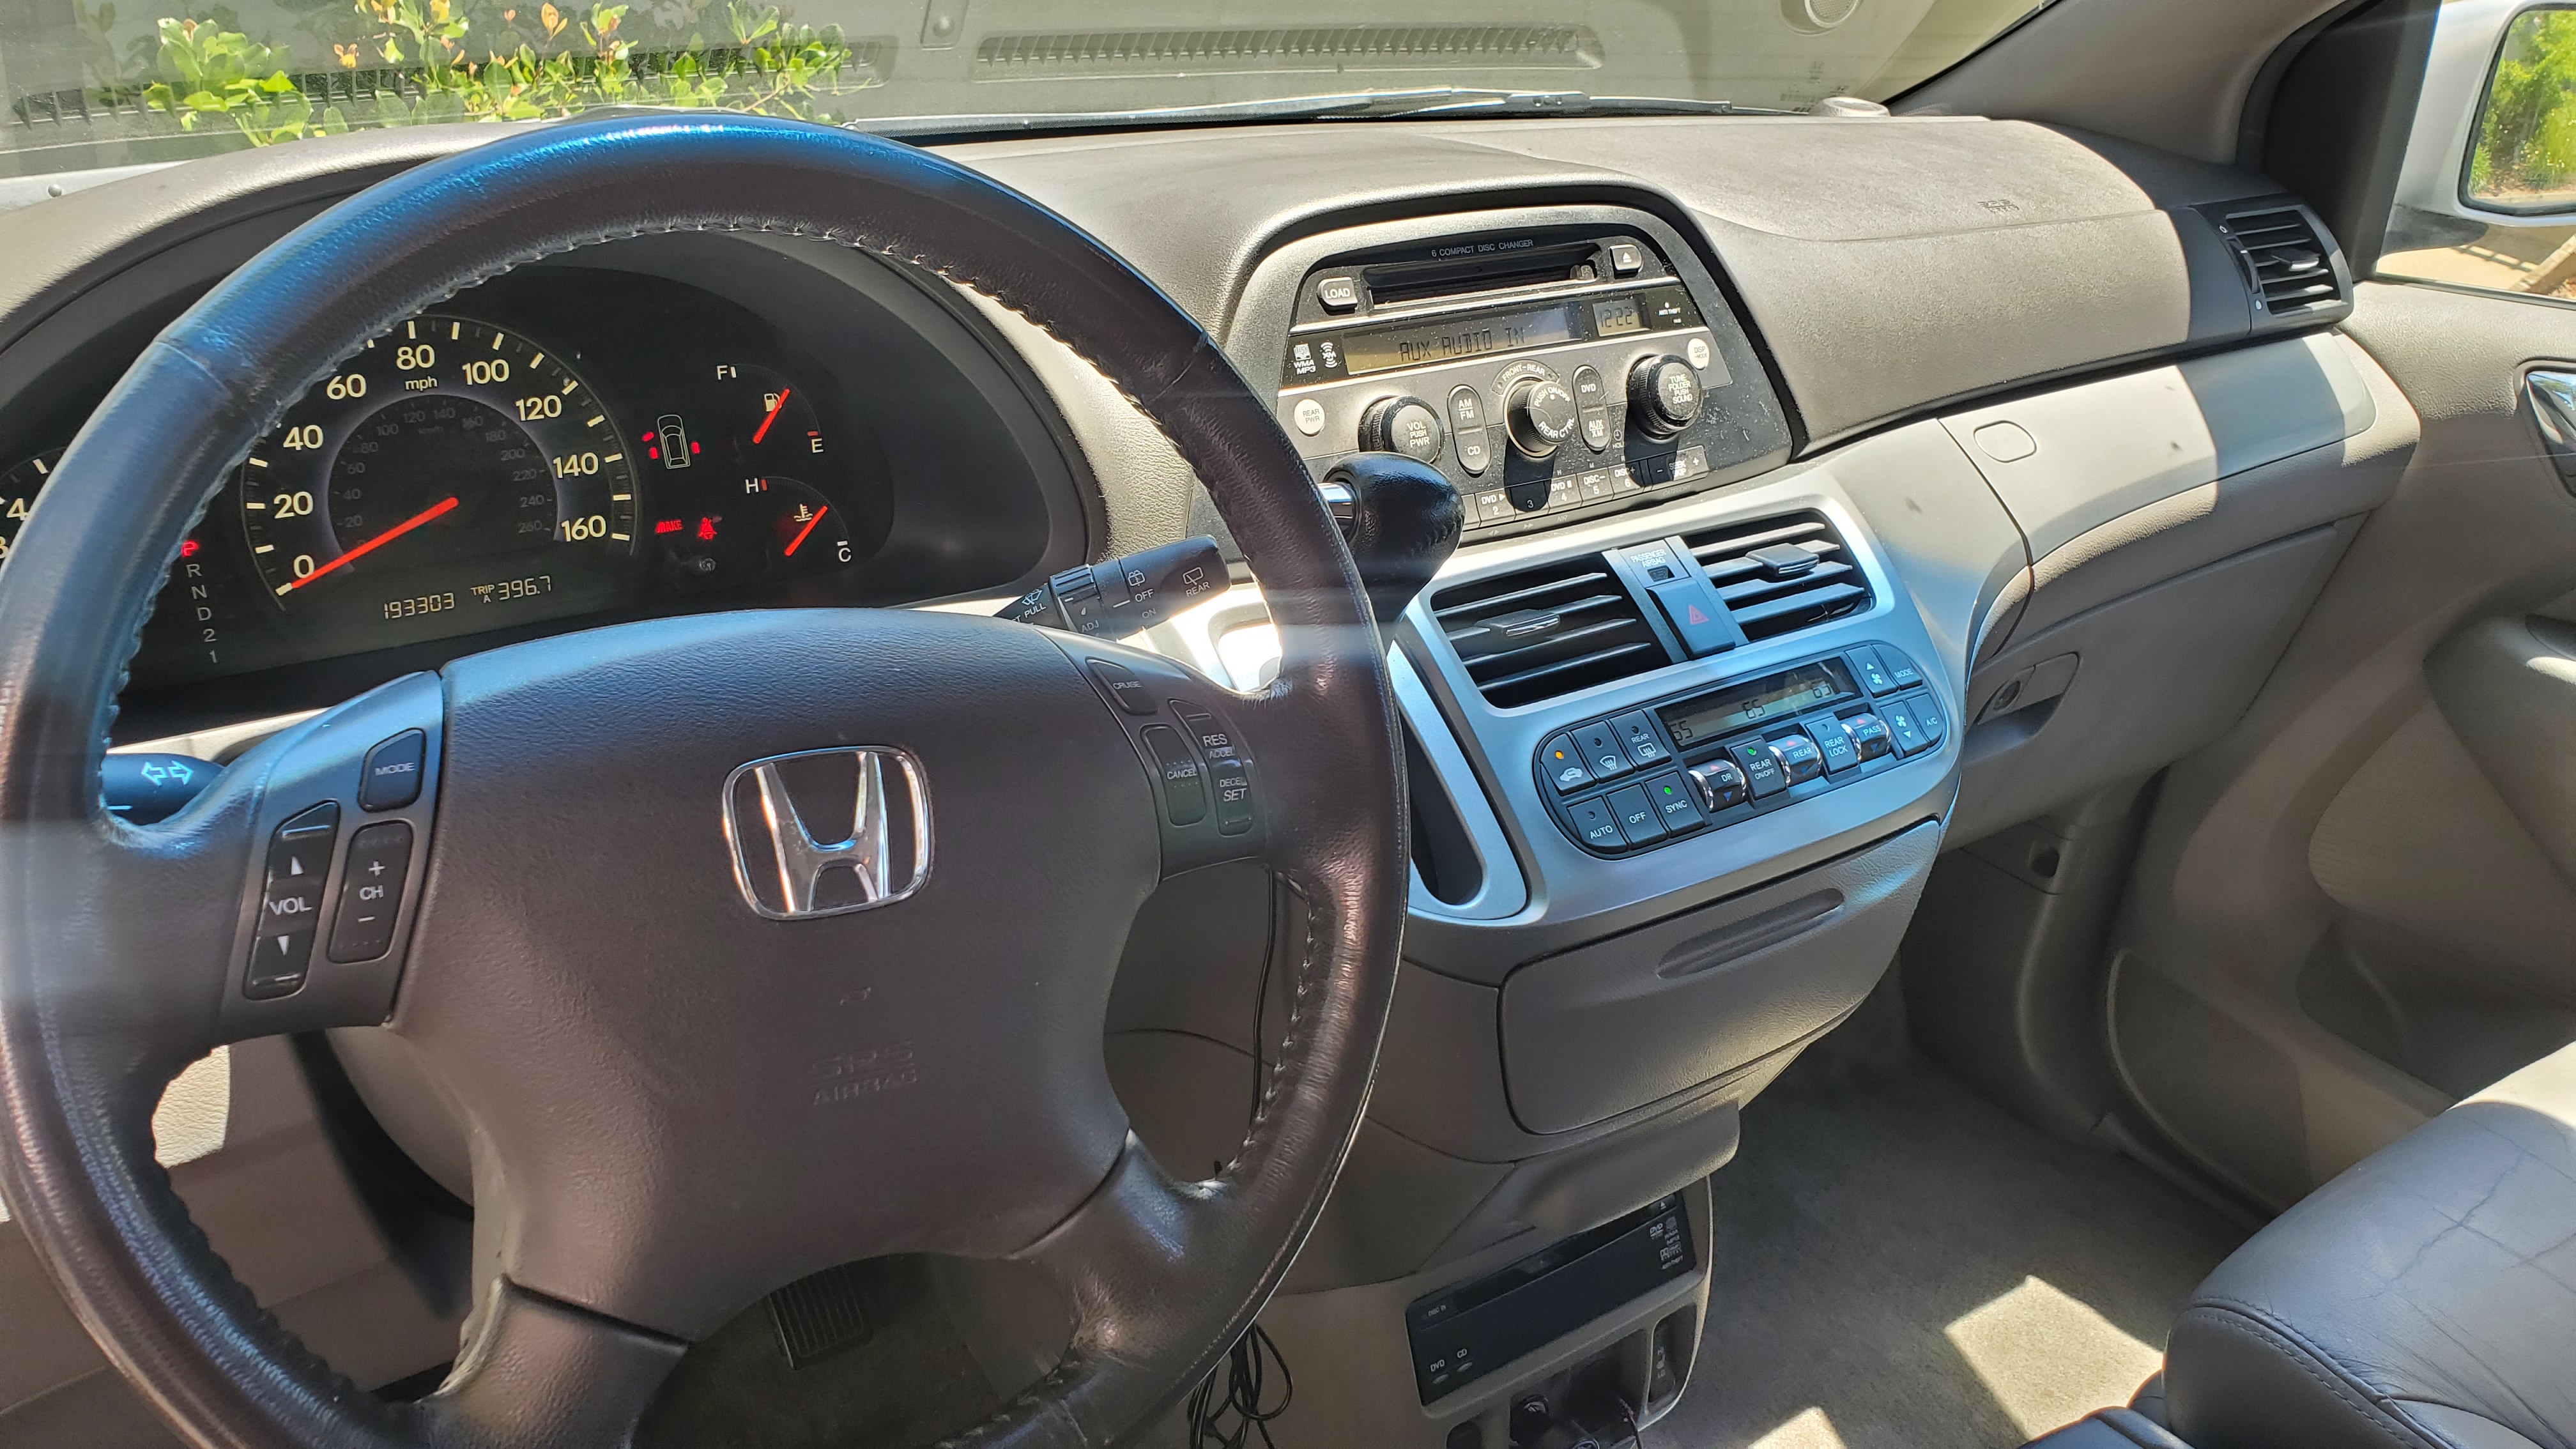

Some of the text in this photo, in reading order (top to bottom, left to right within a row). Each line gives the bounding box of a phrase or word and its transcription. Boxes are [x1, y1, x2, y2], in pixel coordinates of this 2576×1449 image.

[1431, 239, 1533, 257] 6 COMPACT DISC CHANGER
[1324, 288, 1351, 299] LOAD
[1400, 327, 1524, 362] AUX AUDIO IN
[396, 344, 435, 370] 80
[1322, 351, 1337, 359] XM
[1293, 359, 1314, 369] WMA
[1296, 365, 1315, 375] MP3
[462, 359, 509, 385] 100
[717, 365, 728, 380] F
[1669, 374, 1686, 382] TUNE
[326, 374, 367, 400] 60
[405, 376, 438, 392] mph
[1581, 383, 1597, 393] DVD
[1668, 379, 1691, 392] FOLDER
[1459, 398, 1473, 409] AM
[1534, 386, 1570, 408] PUSH ON/OFF
[1673, 394, 1693, 404] SOUND
[516, 395, 562, 422] 120
[1303, 409, 1320, 417] REAR
[1459, 411, 1475, 420] FM
[1406, 420, 1426, 431] VOL
[1538, 417, 1575, 439] REAR CTRL
[1588, 419, 1604, 429] AUX
[283, 424, 324, 451] 40
[1409, 430, 1427, 439] PUSH
[1591, 429, 1604, 438] XM
[811, 438, 824, 454] E
[1409, 436, 1430, 448] PWR
[1467, 446, 1481, 456] CD
[347, 462, 365, 475] 60
[553, 452, 599, 478] 140
[1668, 461, 1685, 471] SEEK
[512, 468, 537, 482] 220
[745, 478, 759, 494] H
[1551, 482, 1565, 492] DVD
[1625, 479, 1630, 487] 6
[344, 488, 362, 500] 40
[1593, 486, 1599, 494] 5
[1662, 484, 1692, 496] CATEGORY
[519, 494, 544, 508] 240
[1481, 495, 1497, 505] DVD
[1527, 499, 1534, 509] 3
[1561, 493, 1567, 502] 4
[6, 498, 29, 521] 4
[273, 491, 314, 519] 20
[1492, 507, 1499, 516] 2
[344, 515, 363, 528] 20
[518, 520, 542, 533] 260
[562, 515, 606, 541] 160
[181, 540, 199, 558] P
[838, 548, 852, 563] C
[1630, 549, 1667, 563] PASSENGER
[1641, 556, 1666, 568] AIRBAG
[186, 564, 203, 578] R
[293, 555, 315, 579] 0
[192, 585, 208, 600] N
[470, 575, 551, 601] TRIP 396.7
[1185, 581, 1211, 597] REAR
[483, 595, 491, 604] A
[1134, 589, 1154, 603] OFF
[383, 592, 455, 619] 193303
[1024, 602, 1046, 618] PULL
[197, 607, 212, 621] D
[1142, 608, 1157, 618] ON
[1082, 620, 1100, 633] ADJ
[203, 628, 217, 643] 2
[209, 650, 217, 664] 1
[1894, 668, 1913, 678] MODE
[1113, 680, 1142, 691] CRUISE
[1925, 717, 1938, 726] A/C
[1862, 724, 1882, 736] PASS
[1202, 733, 1227, 746] RES
[1630, 733, 1650, 744] REAR
[1823, 735, 1844, 749] REAR
[1209, 747, 1236, 759] ACCEL
[1792, 746, 1813, 760] REAR
[1828, 745, 1848, 758] LOCK
[374, 762, 415, 776] MODE
[1749, 758, 1772, 771] REAR
[1167, 768, 1197, 780] CANCEL
[1721, 772, 1733, 782] DR
[1754, 767, 1775, 780] ON/OFF
[1223, 788, 1247, 802] SET
[1665, 800, 1687, 814] SYNC
[1629, 811, 1646, 824] OFF
[1589, 825, 1613, 839] AUTO
[359, 885, 384, 901] CH
[268, 897, 312, 916] VOL
[1457, 1348, 1468, 1358] CD
[1430, 1359, 1445, 1372] DVD
